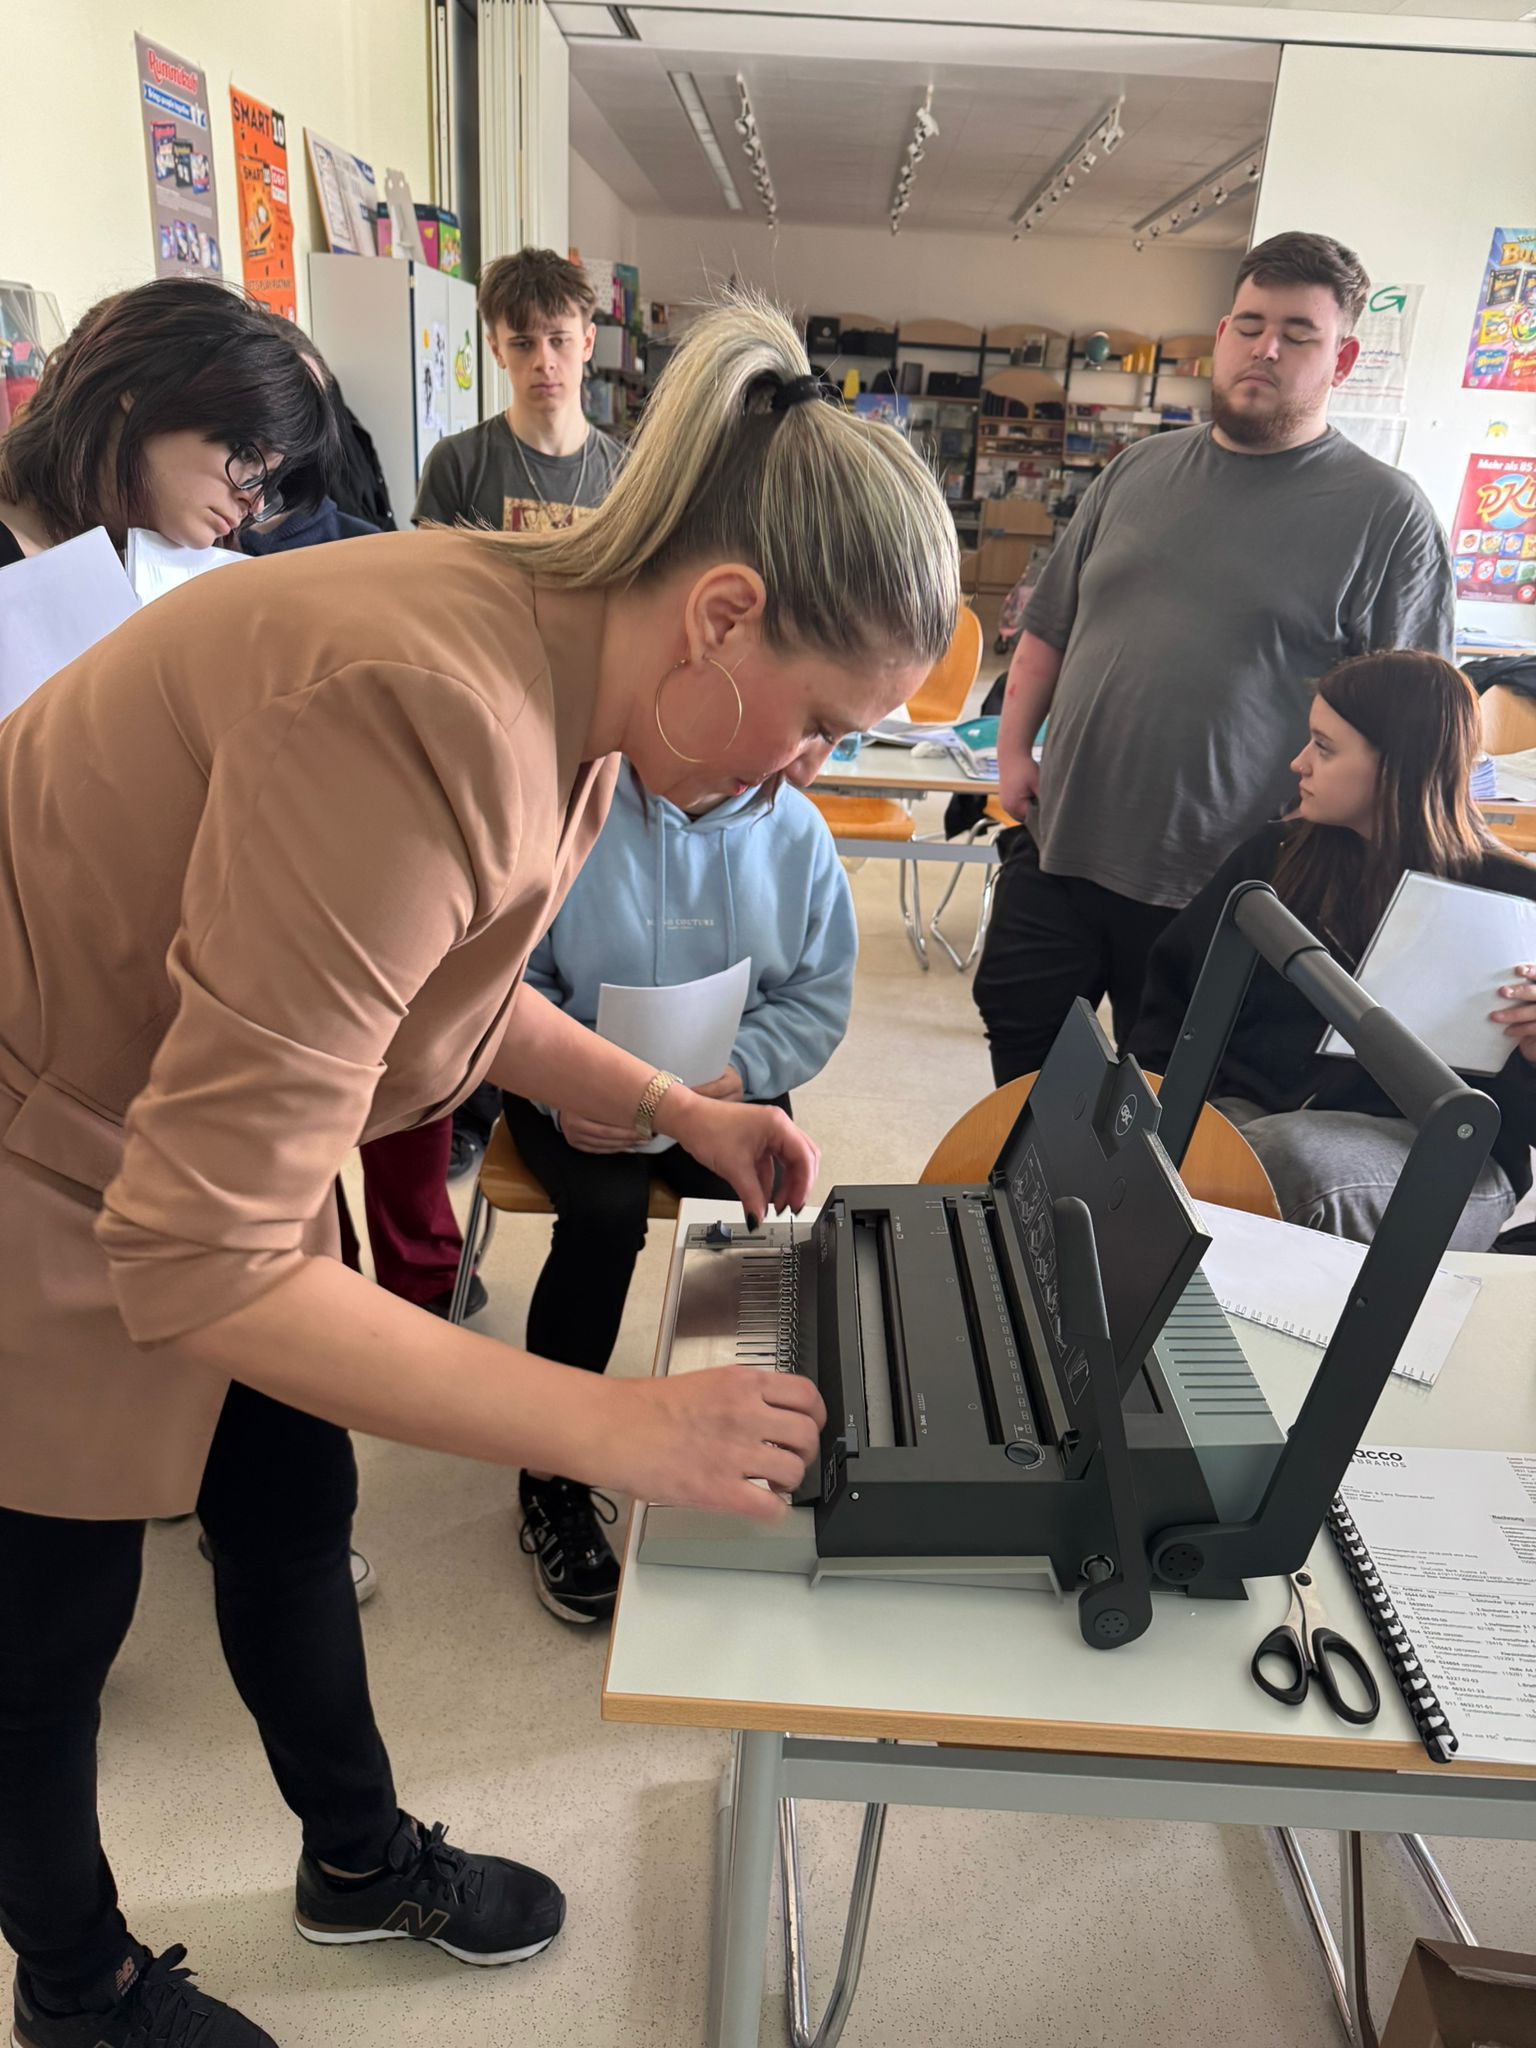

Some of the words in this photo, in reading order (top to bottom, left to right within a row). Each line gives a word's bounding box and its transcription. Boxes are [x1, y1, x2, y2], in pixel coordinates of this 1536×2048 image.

[233, 97, 270, 138] SMART
[272, 115, 285, 147] 10
[1478, 458, 1504, 470] Mehr
[1504, 461, 1519, 471] als
[1353, 1449, 1402, 1461] acco
[1357, 1459, 1407, 1468] BRANDS
